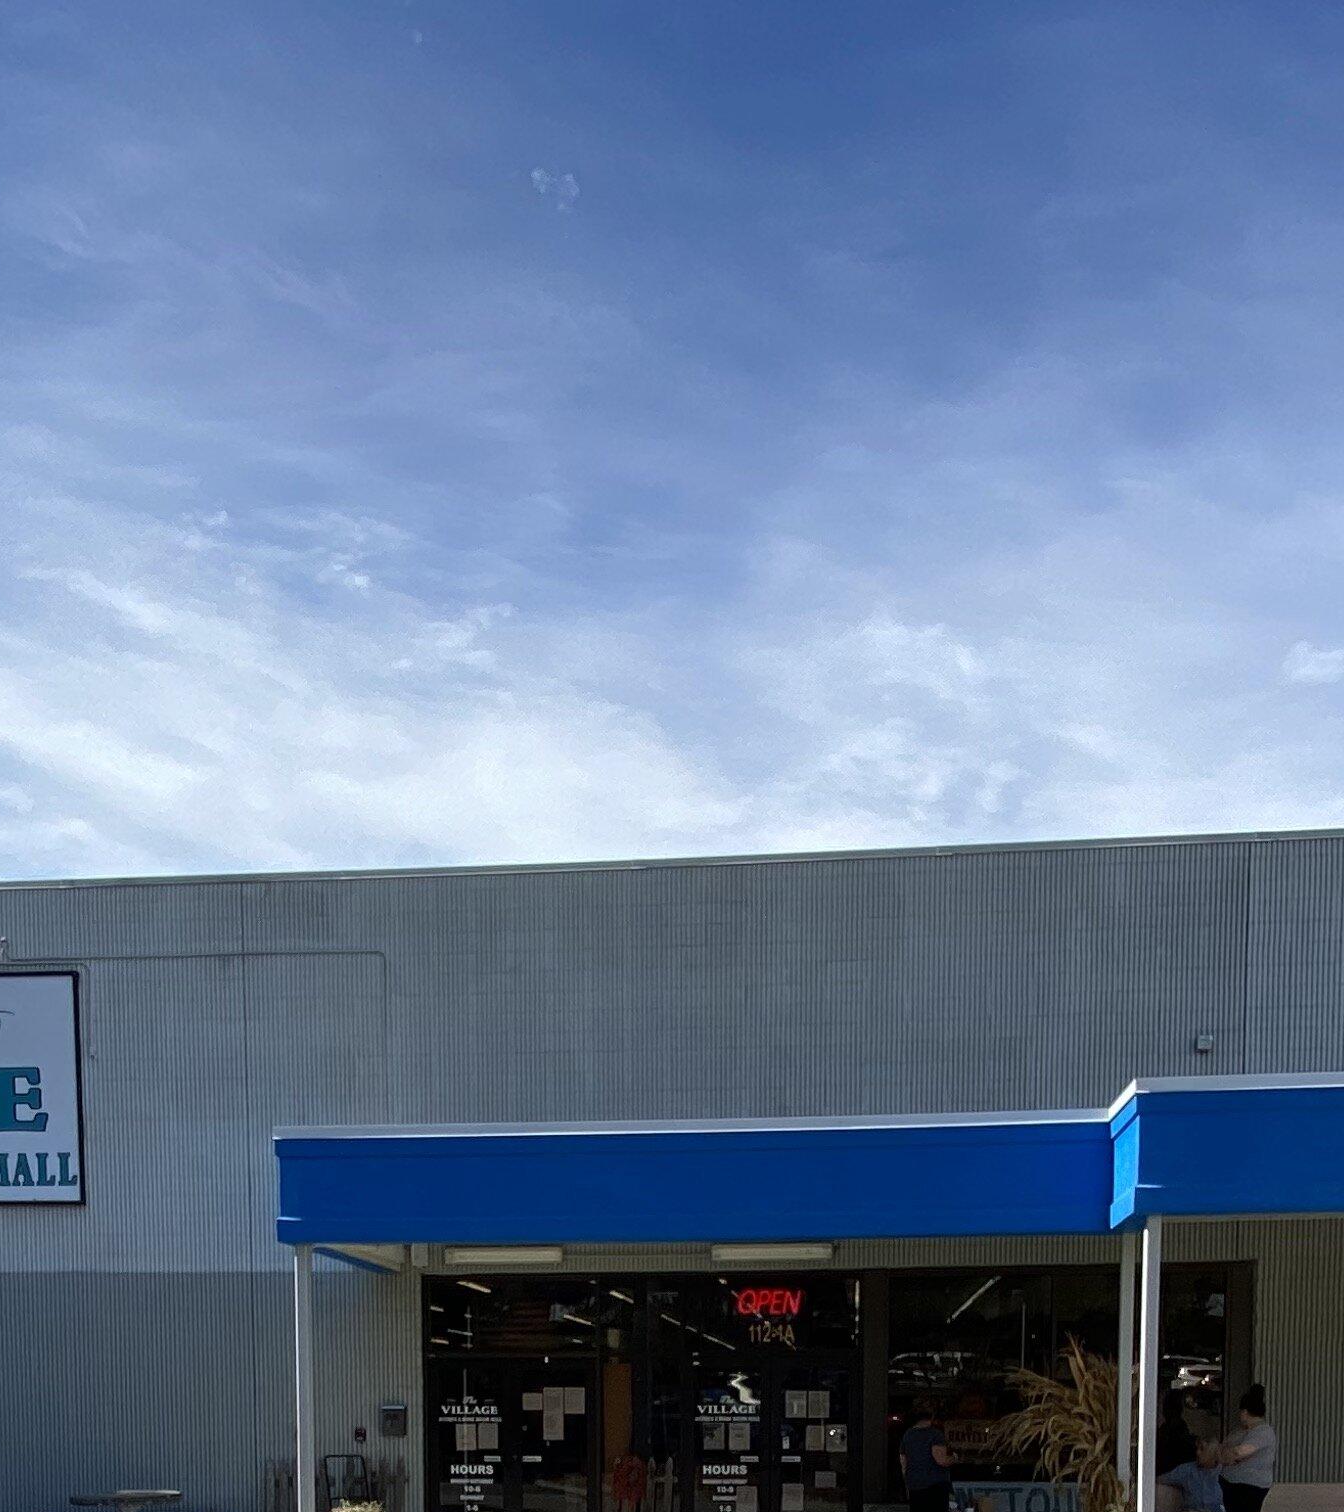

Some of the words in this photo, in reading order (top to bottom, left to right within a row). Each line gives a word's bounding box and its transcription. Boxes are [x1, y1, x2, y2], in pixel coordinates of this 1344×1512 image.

[737, 1288, 801, 1316] OPEN
[440, 1405, 497, 1415] VILLAGE
[697, 1404, 756, 1414] VILLAGE
[450, 1464, 494, 1475] HOURS
[702, 1464, 747, 1475] HOURS
